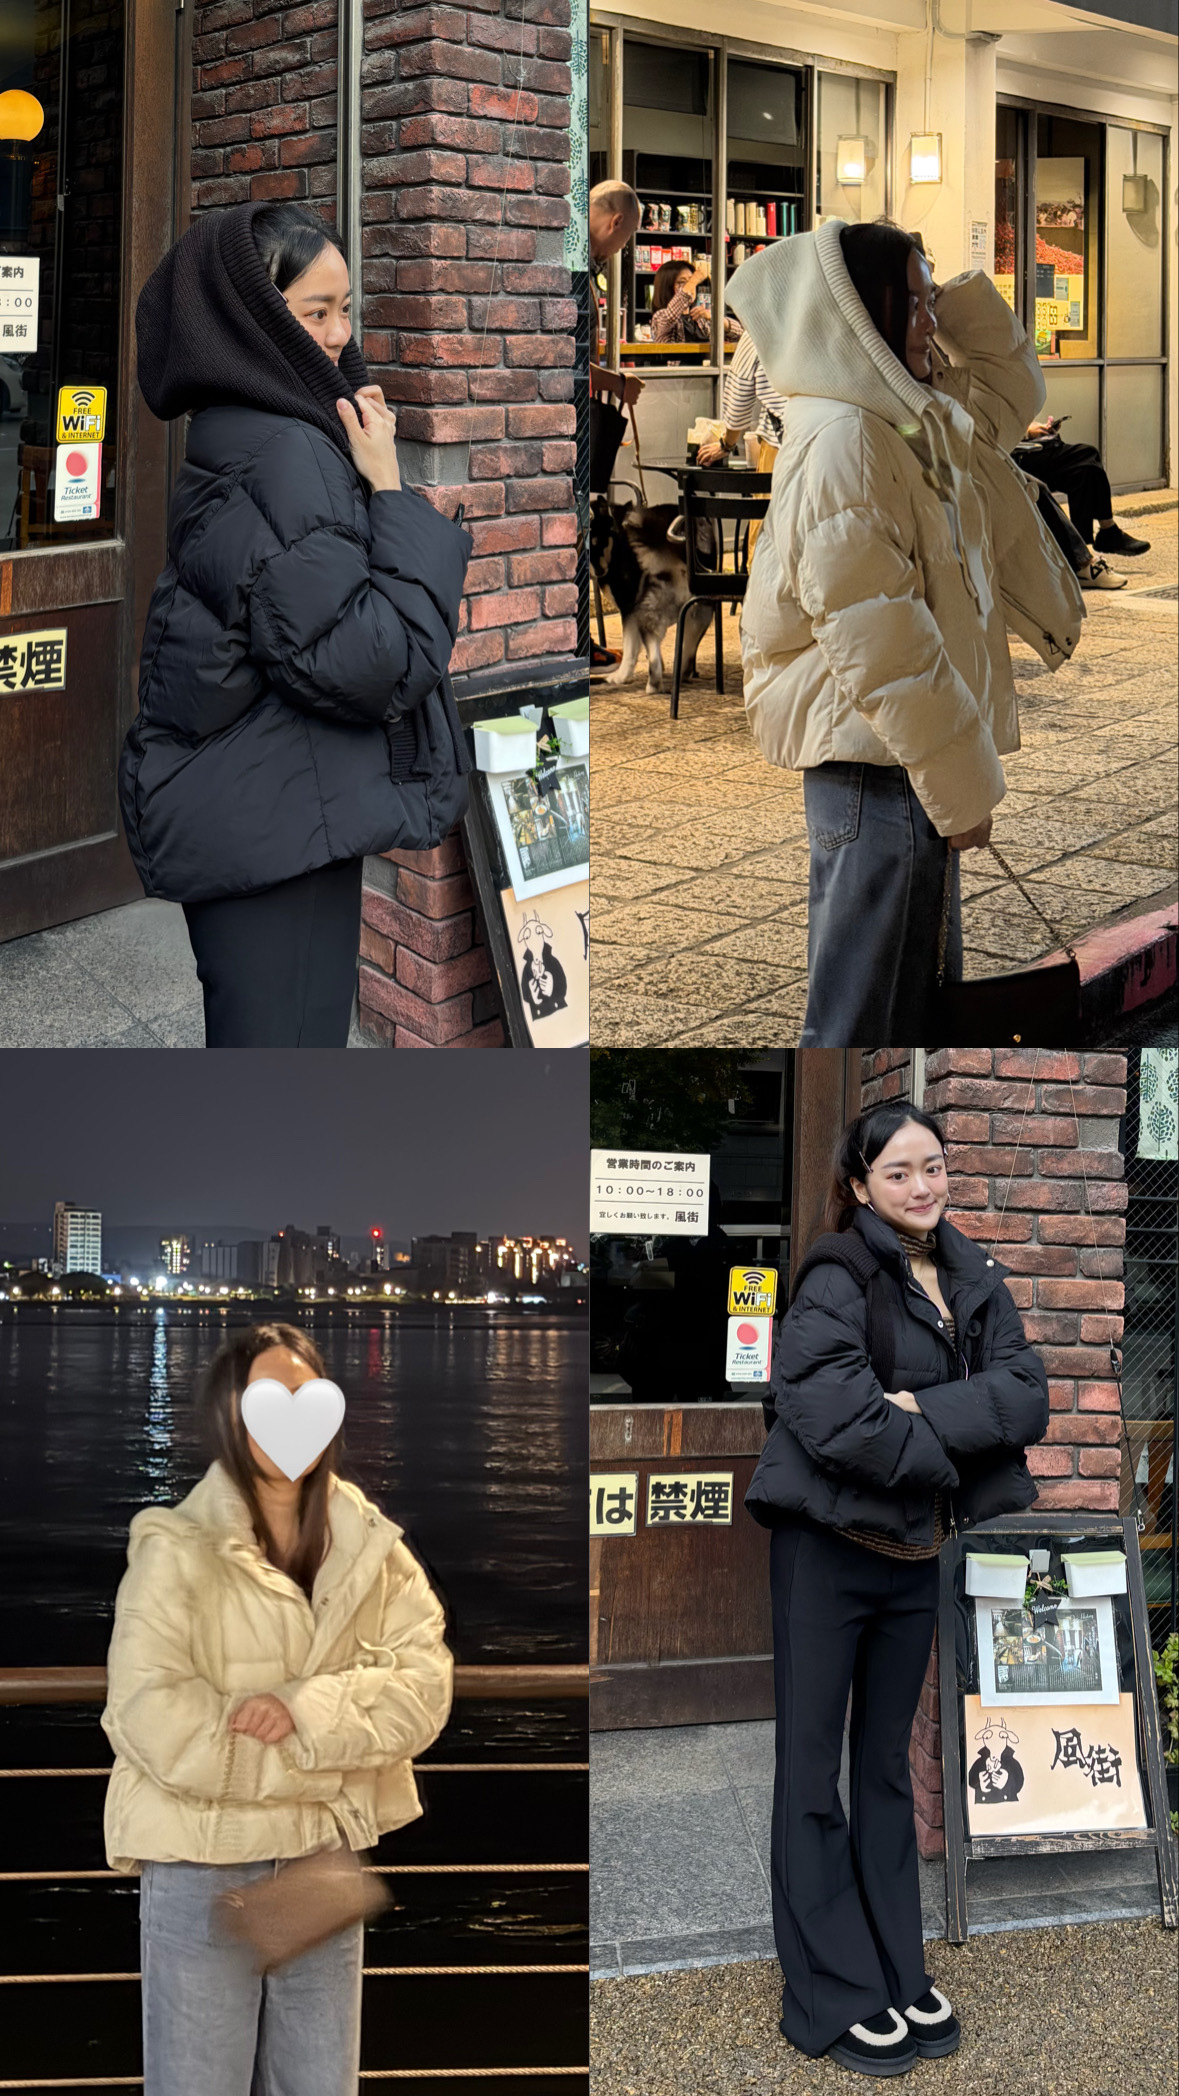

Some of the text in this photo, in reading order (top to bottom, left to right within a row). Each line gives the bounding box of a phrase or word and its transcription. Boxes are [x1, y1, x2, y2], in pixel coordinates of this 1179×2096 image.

[0, 266, 24, 278] 案内
[2, 324, 27, 337] 風街
[73, 407, 91, 415] FREE
[62, 415, 101, 431] WiFi
[68, 431, 100, 439] INTERNET
[64, 486, 88, 495] Ticket
[61, 493, 91, 501] Restaurant
[606, 1158, 696, 1172] 営業時間のご案内
[674, 1211, 699, 1223] 風街
[733, 1291, 772, 1308] WiFi
[735, 1352, 759, 1360] Ticket
[650, 1481, 731, 1520] 禁煙
[1031, 1603, 1058, 1614] Welcome
[1050, 1727, 1122, 1788] 風街
